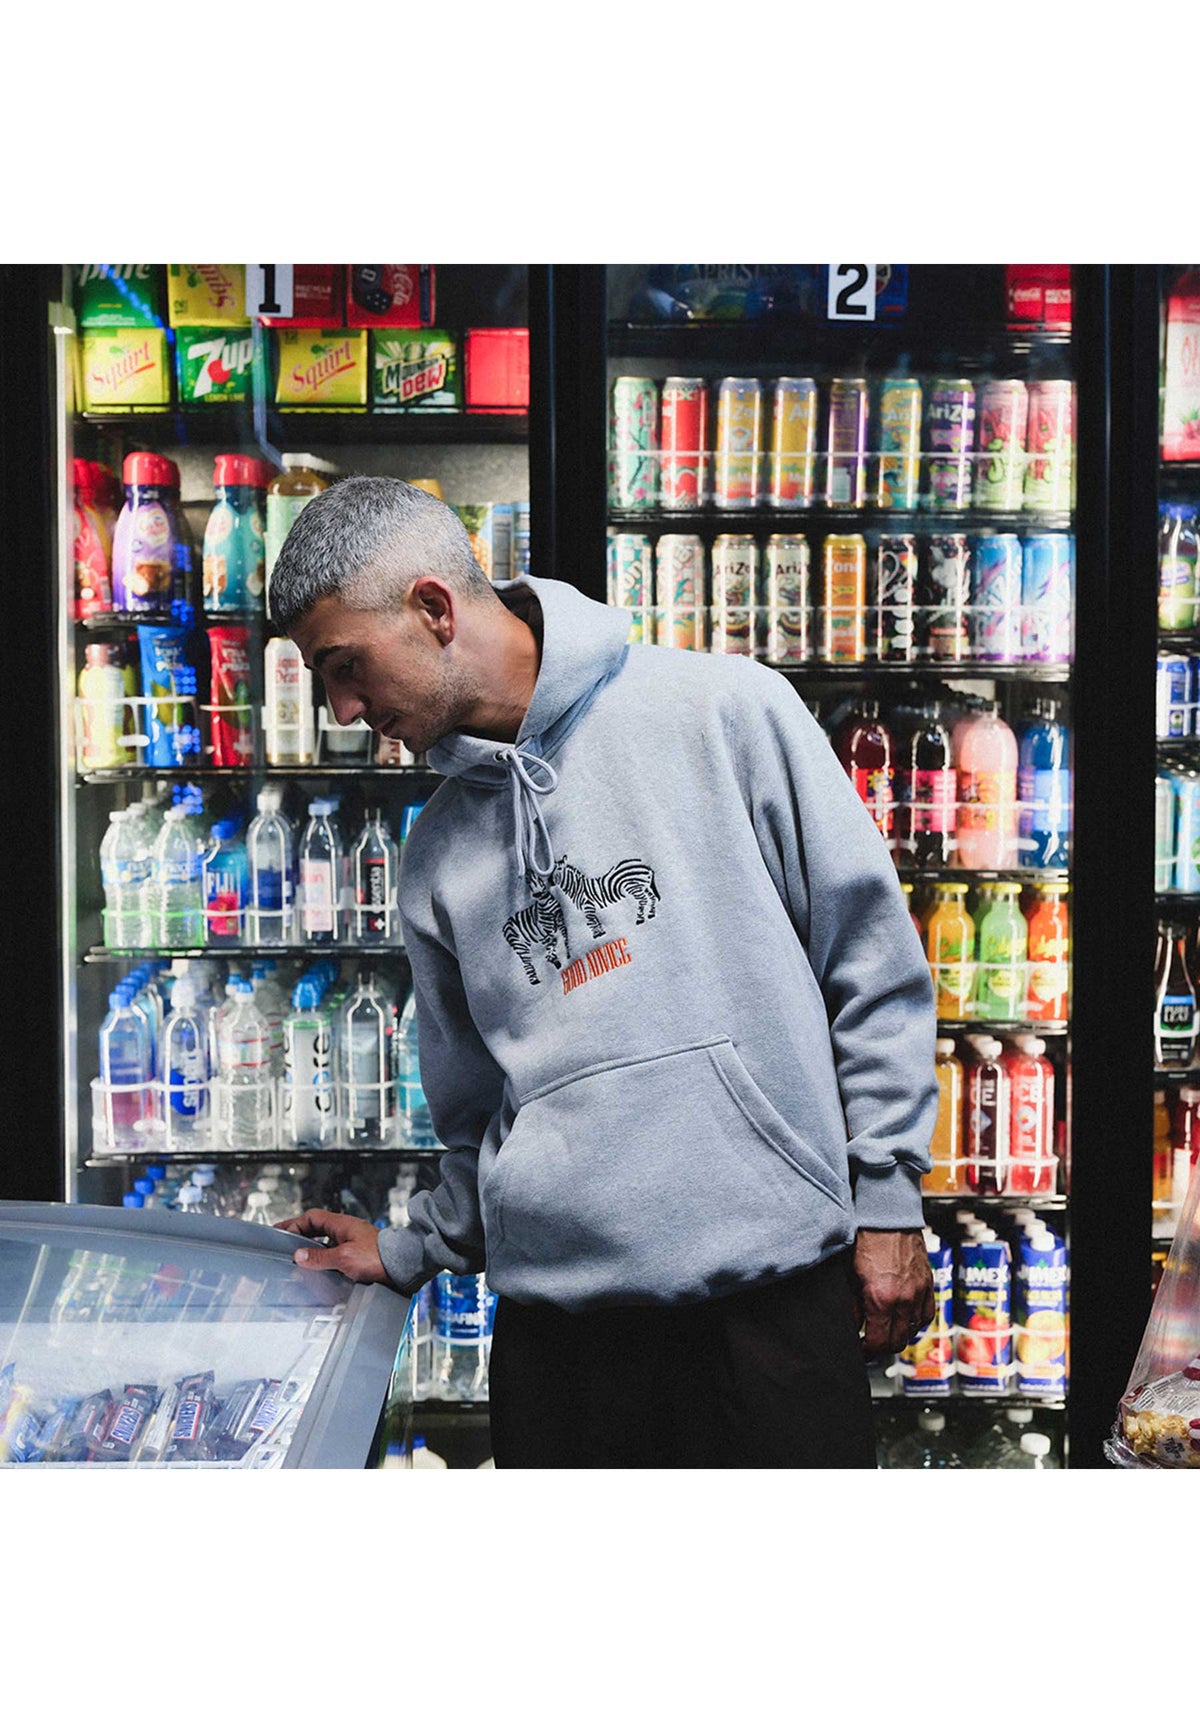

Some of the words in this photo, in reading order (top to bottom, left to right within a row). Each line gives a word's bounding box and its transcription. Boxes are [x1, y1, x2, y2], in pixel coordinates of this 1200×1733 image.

[258, 264, 281, 313] 1
[835, 264, 868, 316] 2
[291, 340, 353, 393] Squirt
[561, 958, 588, 996] GOOD
[585, 936, 632, 981] ADVICE
